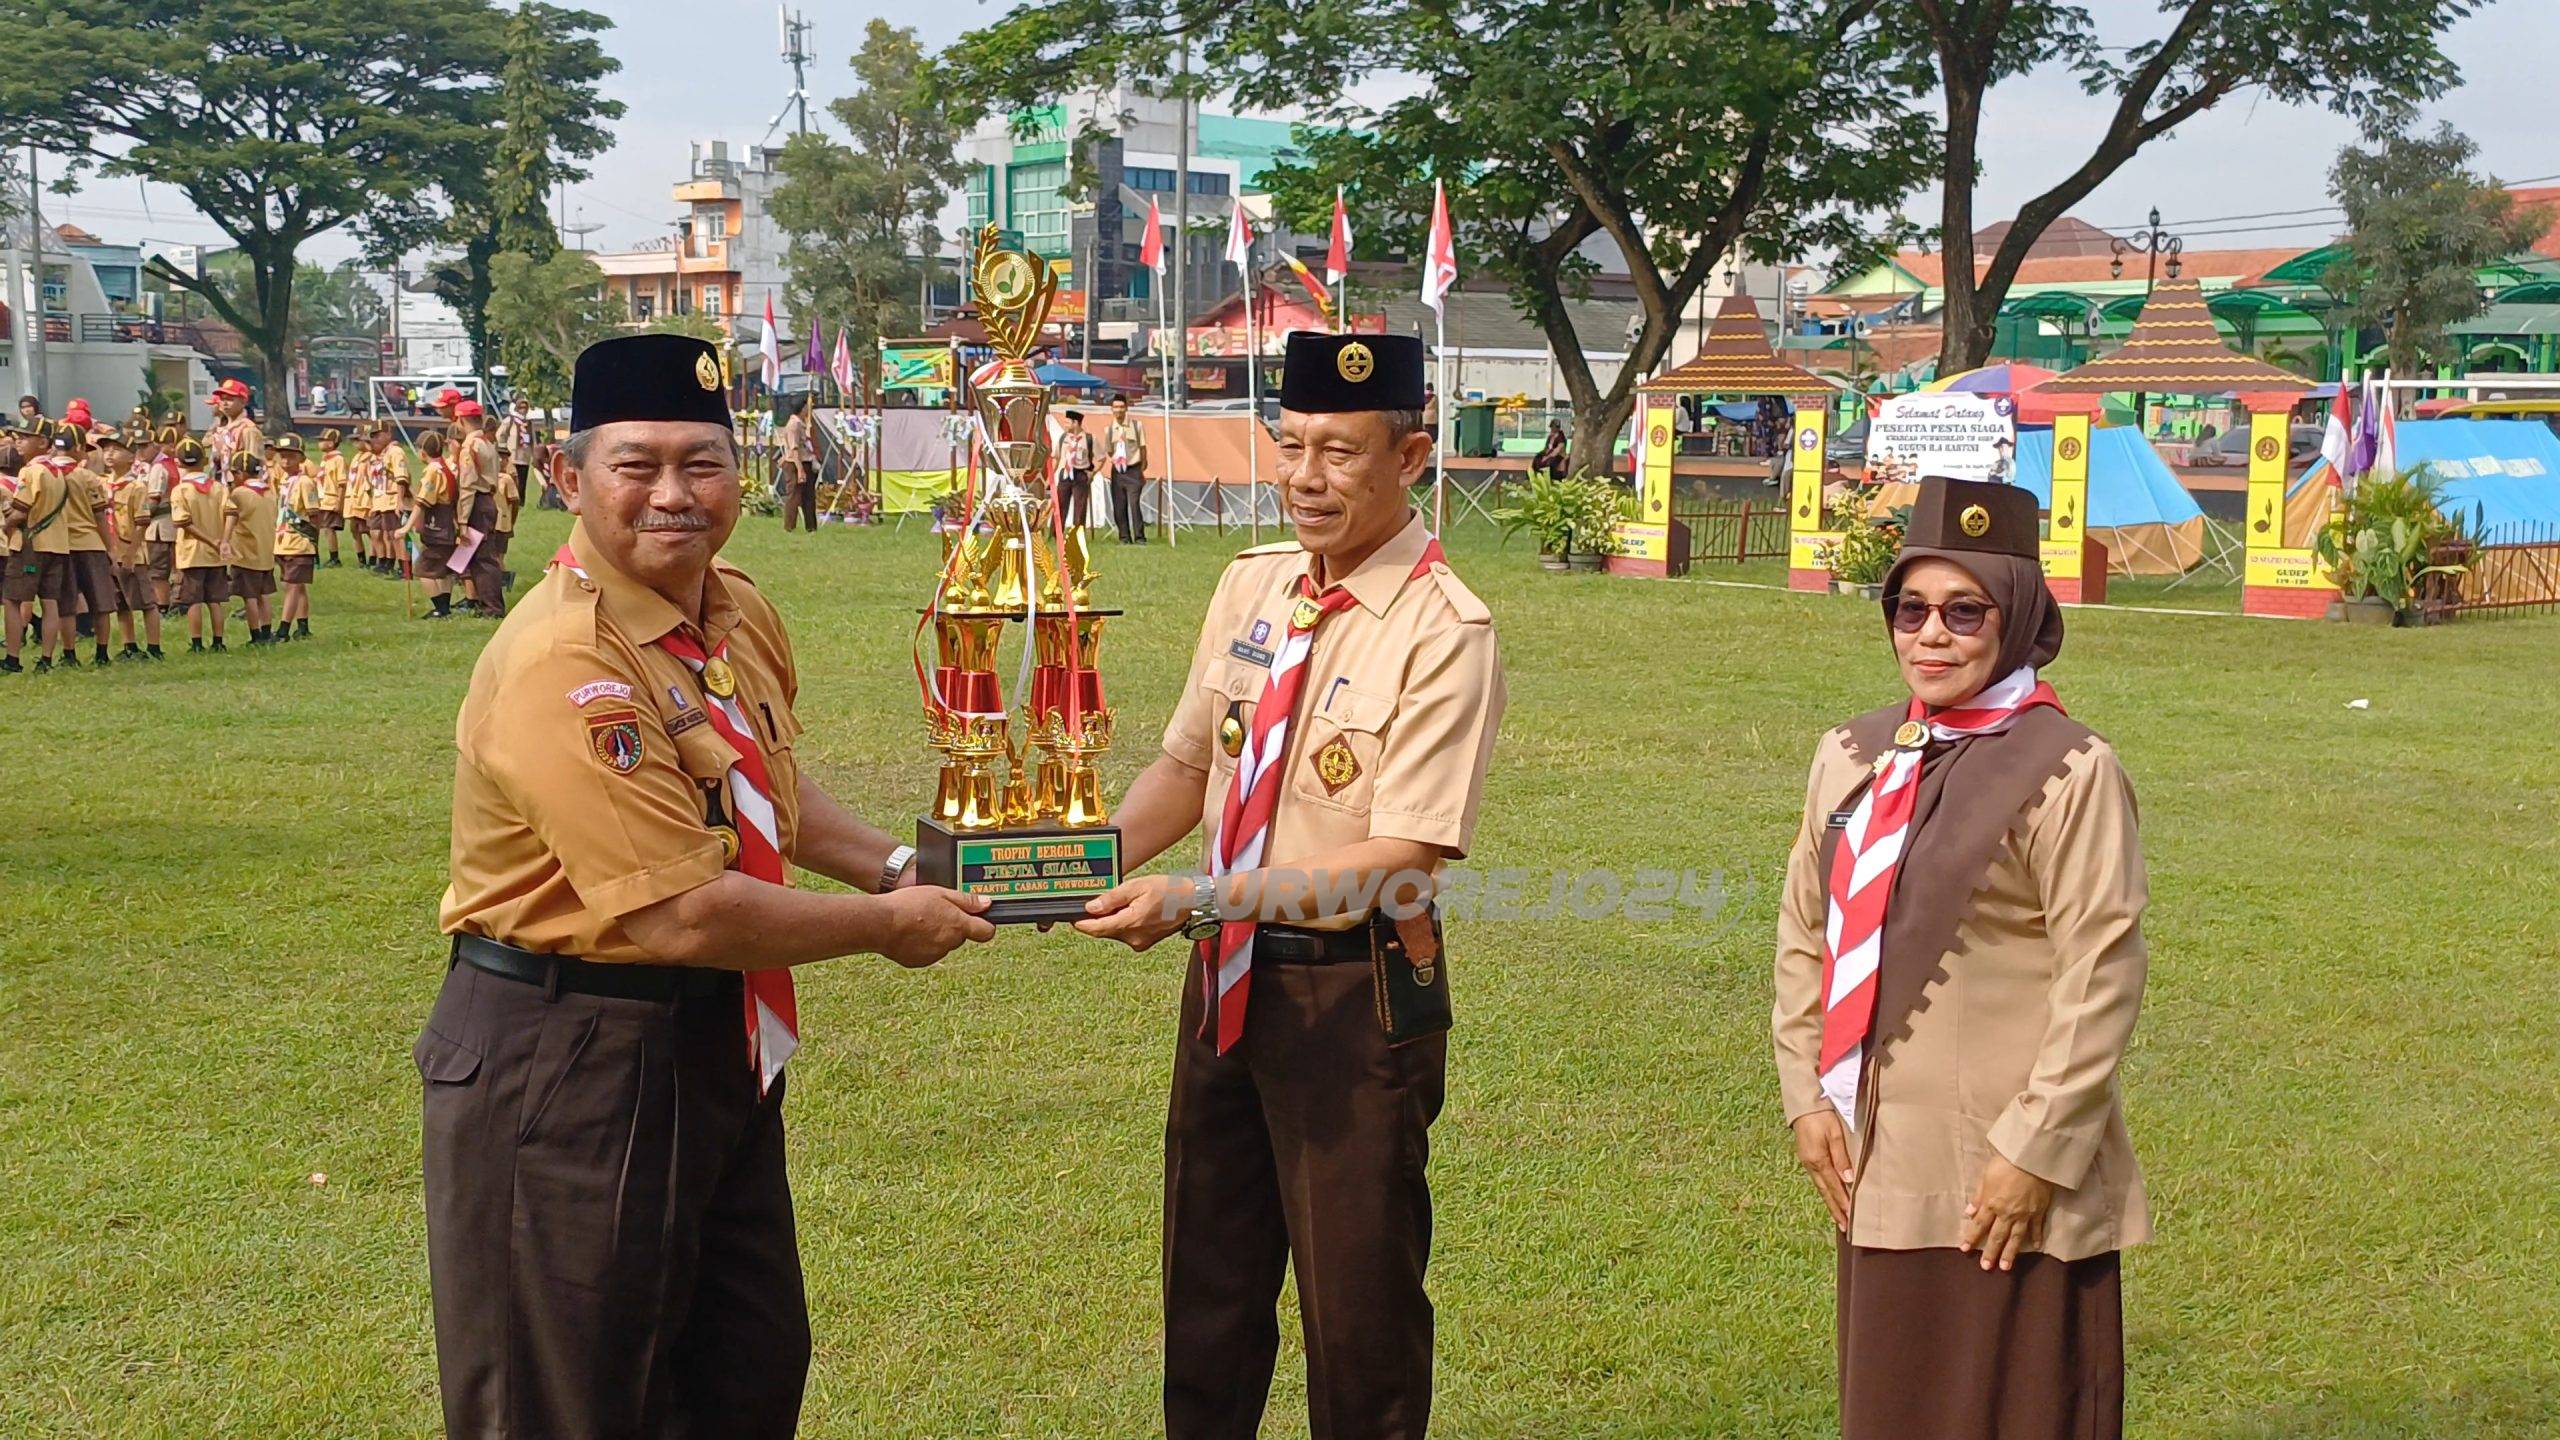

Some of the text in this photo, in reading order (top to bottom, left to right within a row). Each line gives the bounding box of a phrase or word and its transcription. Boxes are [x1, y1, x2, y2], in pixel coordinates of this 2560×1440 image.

[1896, 405, 1985, 421] Selamat Datang
[1875, 424, 2005, 433] PESERTA PESTA SIAGA
[573, 683, 629, 701] PURWOREJO
[991, 844, 1085, 861] TROPHY BERGILIR
[983, 860, 1092, 879] PESTA SIAGA
[970, 879, 1107, 893] KWARTIR CABANG PURWOREJO
